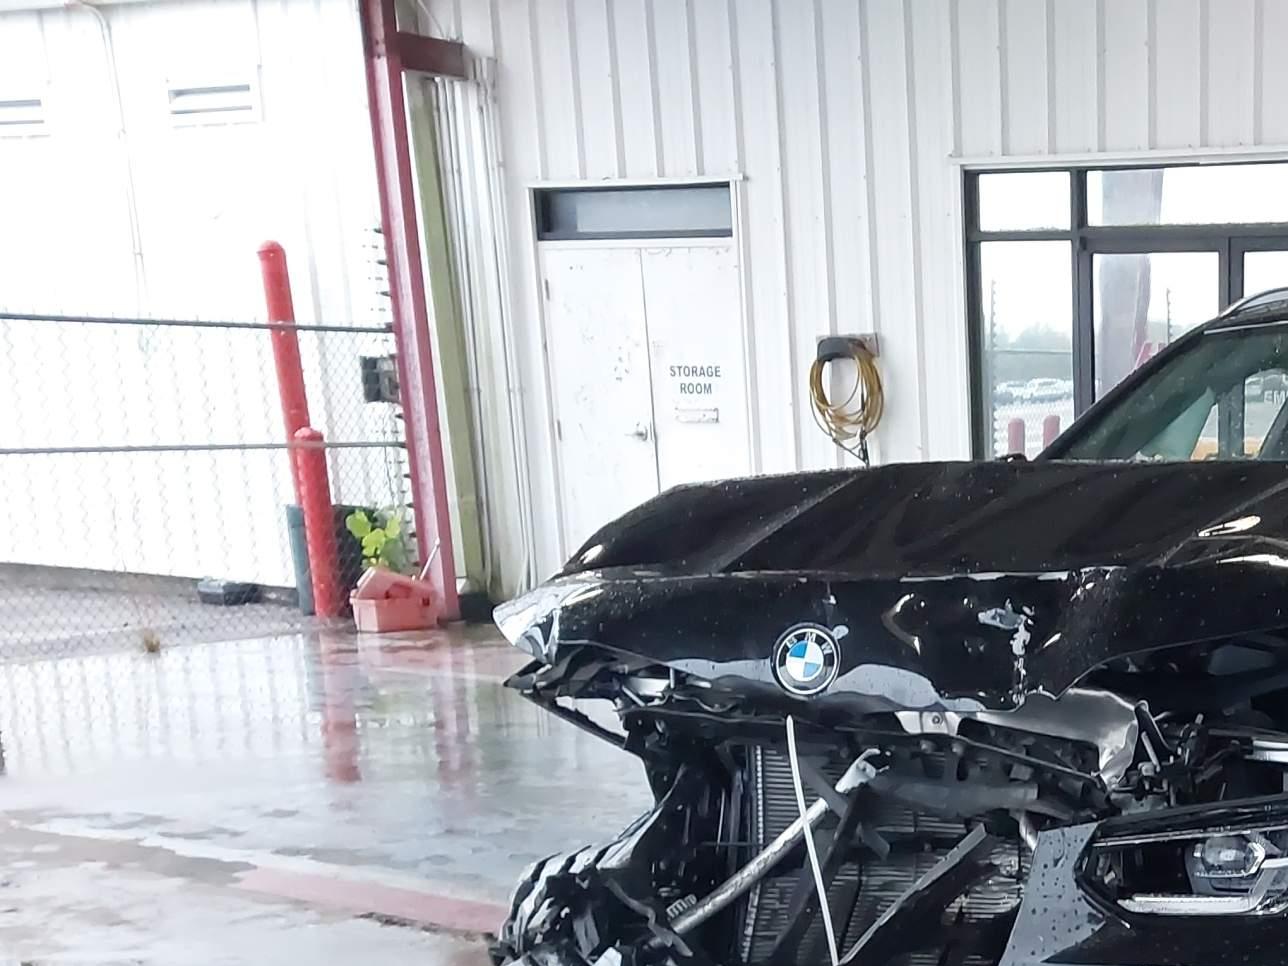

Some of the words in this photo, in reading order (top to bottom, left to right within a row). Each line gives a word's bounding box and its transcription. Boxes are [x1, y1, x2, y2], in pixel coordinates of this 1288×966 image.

[669, 365, 721, 378] STORAGE
[680, 382, 713, 395] ROOM
[784, 631, 833, 656] BMW
